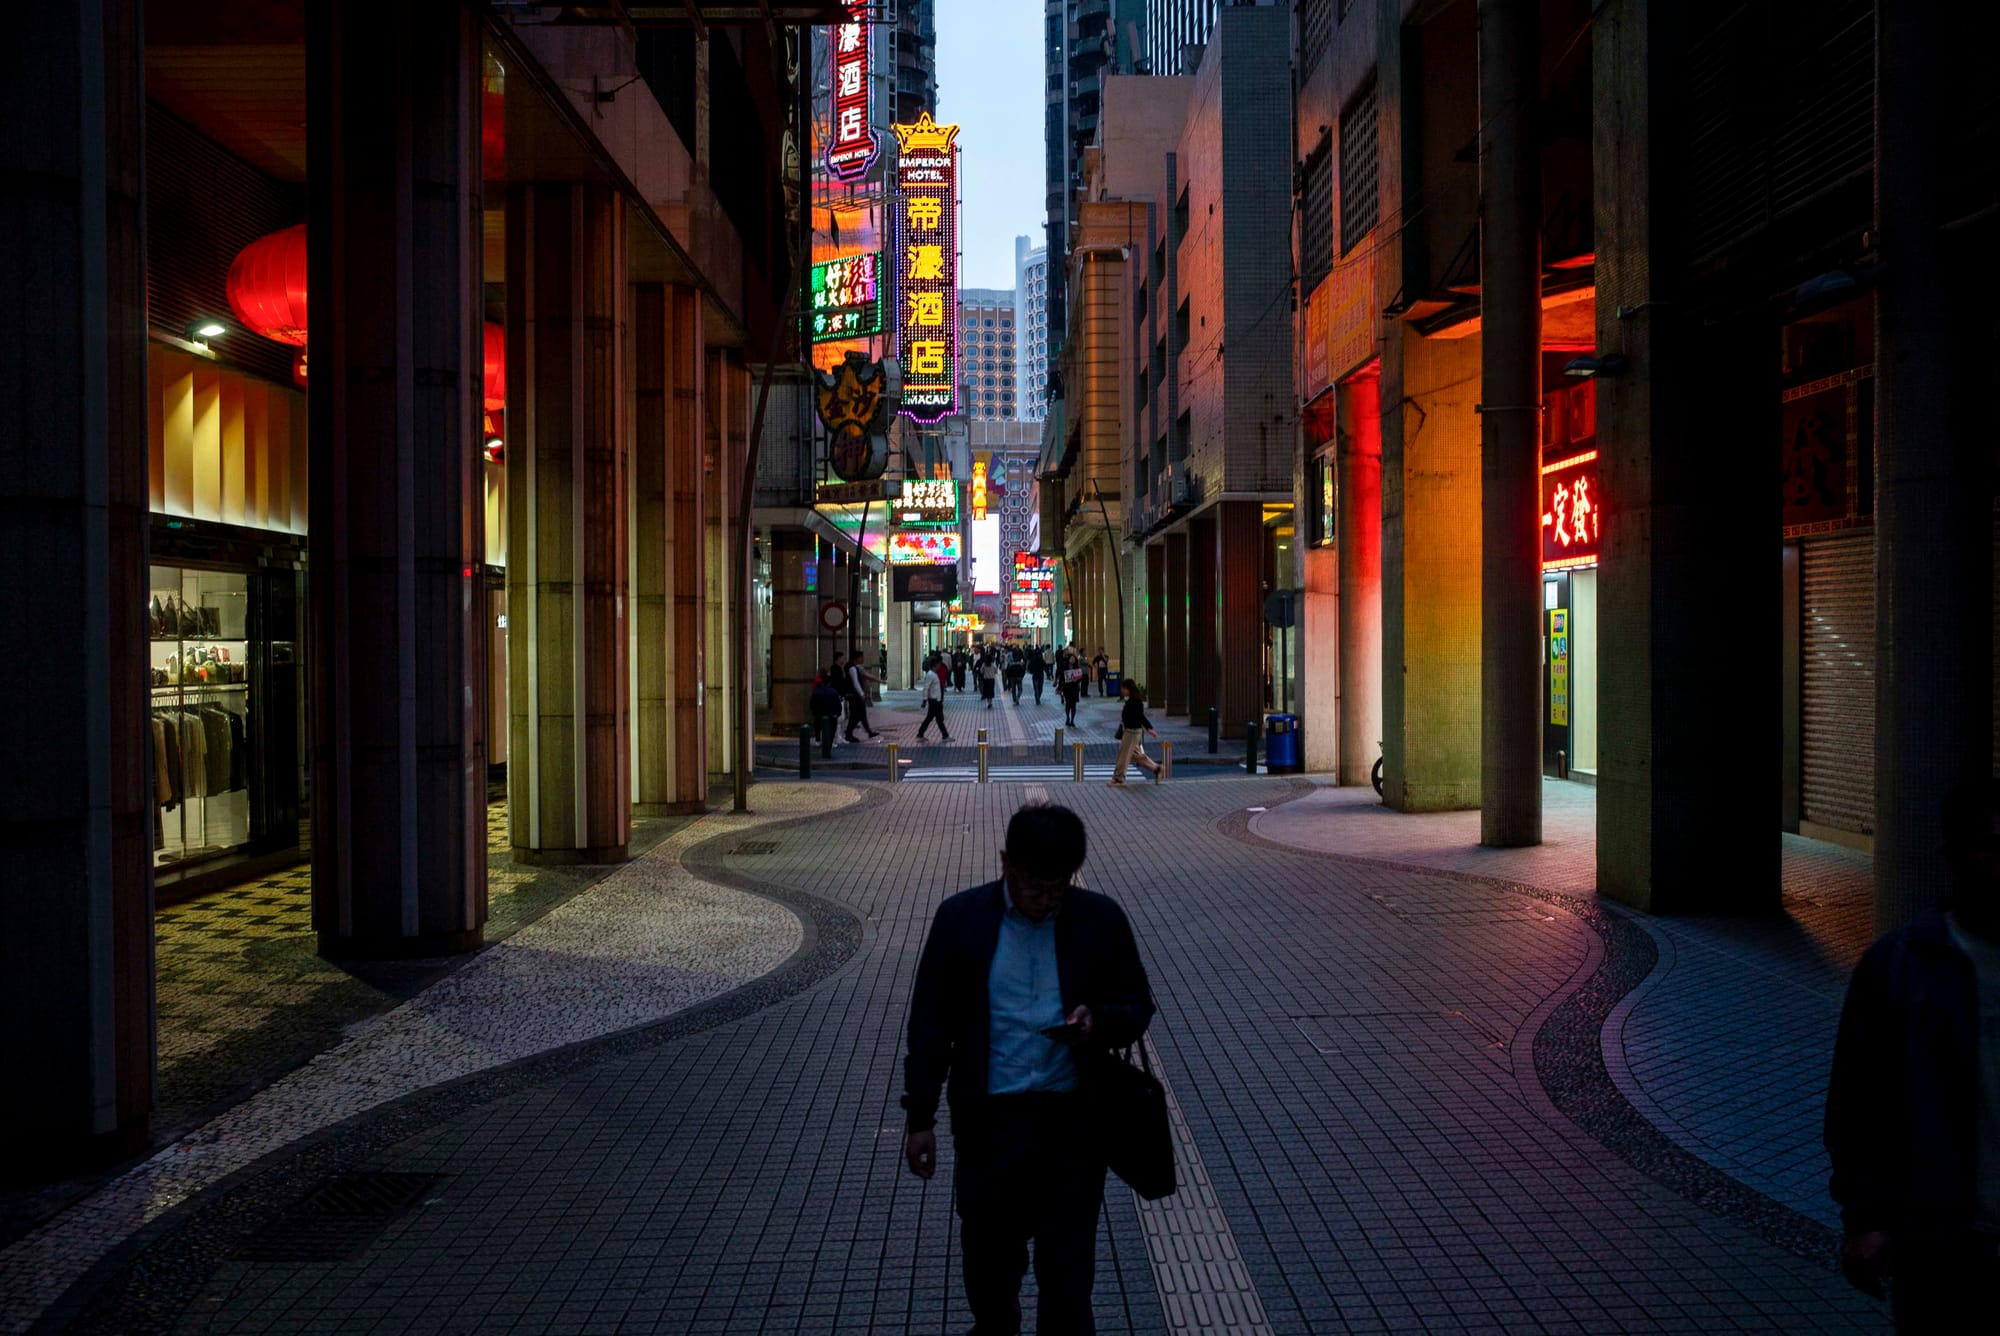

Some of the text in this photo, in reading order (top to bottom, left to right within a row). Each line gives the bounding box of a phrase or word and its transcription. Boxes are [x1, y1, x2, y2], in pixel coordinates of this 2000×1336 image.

[838, 0, 861, 142] 濠酒店
[831, 150, 870, 164] EMPEROR HOTEL
[899, 157, 951, 168] EMPEROR
[907, 170, 943, 180] HOTEL
[907, 197, 945, 374] 帝濠酒店
[907, 395, 949, 405] MACAU
[1543, 475, 1598, 548] 一定發
